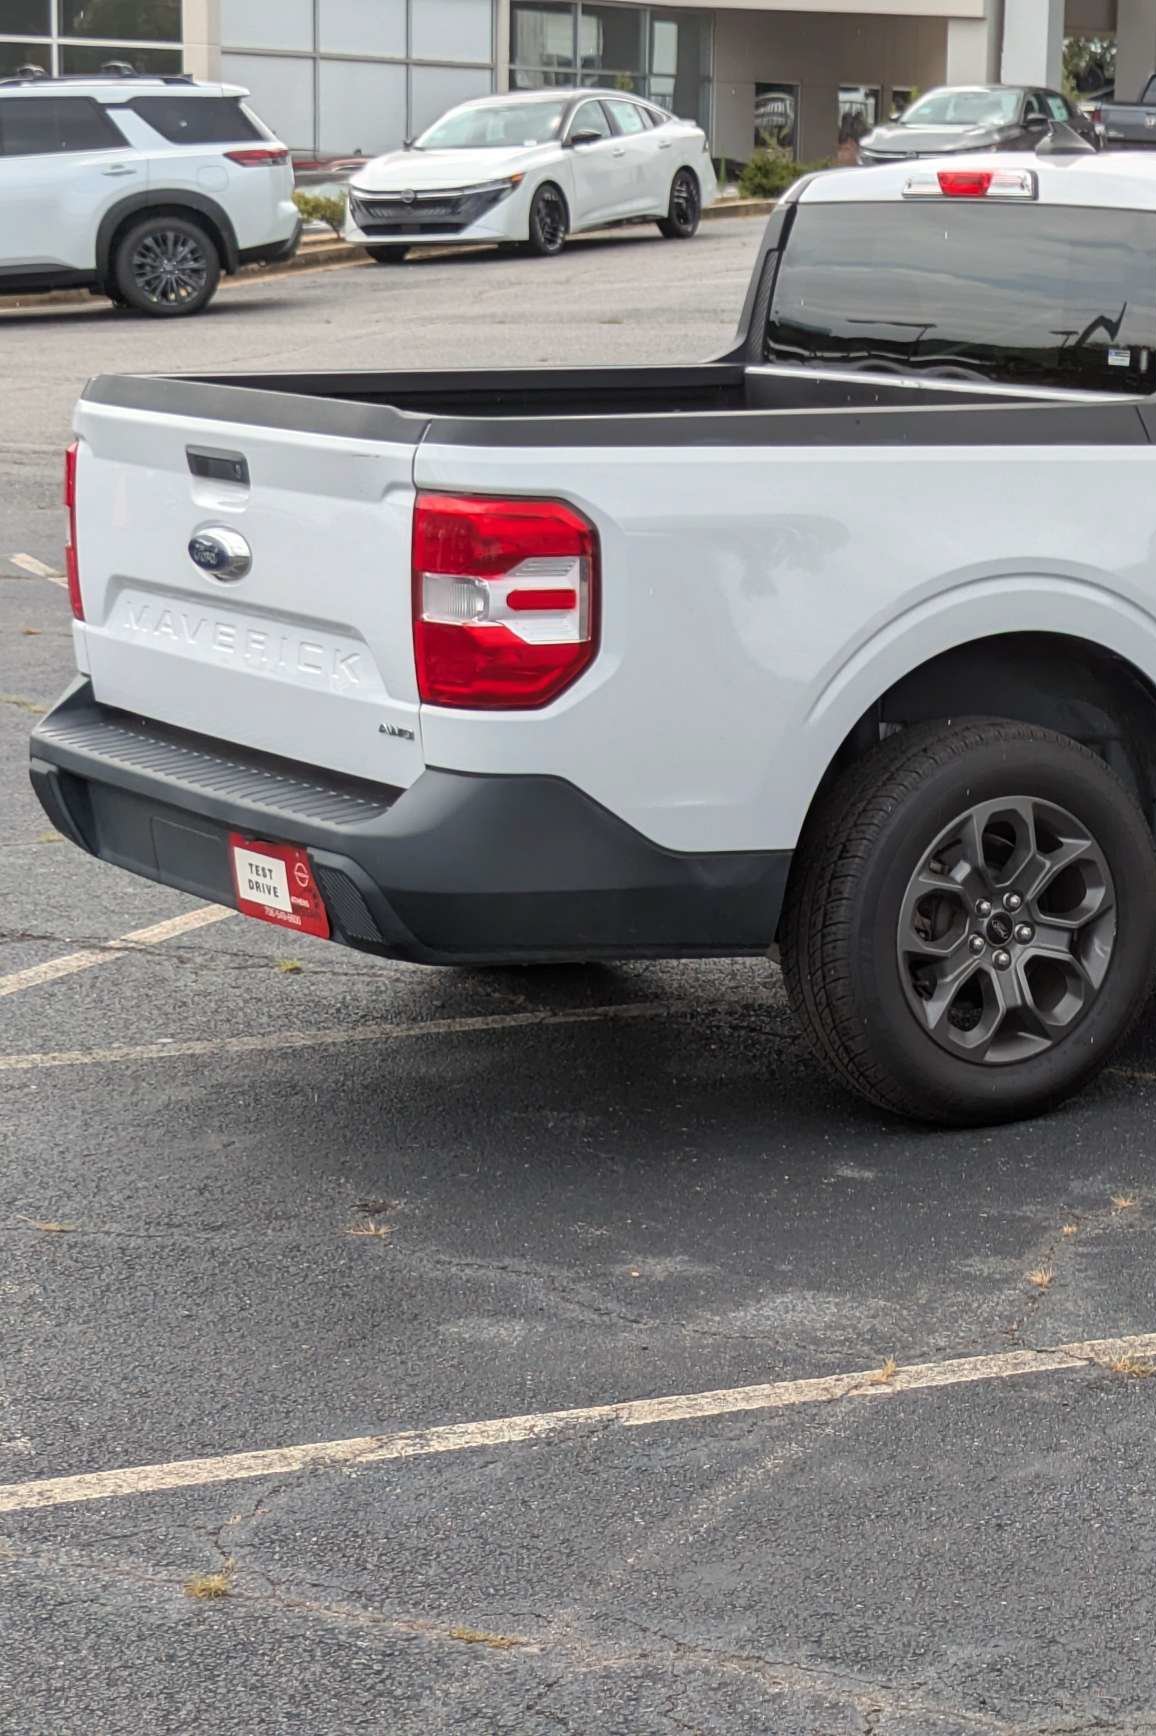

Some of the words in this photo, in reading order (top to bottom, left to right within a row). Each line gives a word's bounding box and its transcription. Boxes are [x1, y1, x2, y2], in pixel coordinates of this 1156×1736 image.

[122, 601, 361, 684] MAVERICK
[248, 863, 274, 880] TEST
[248, 880, 280, 898] DRIVE
